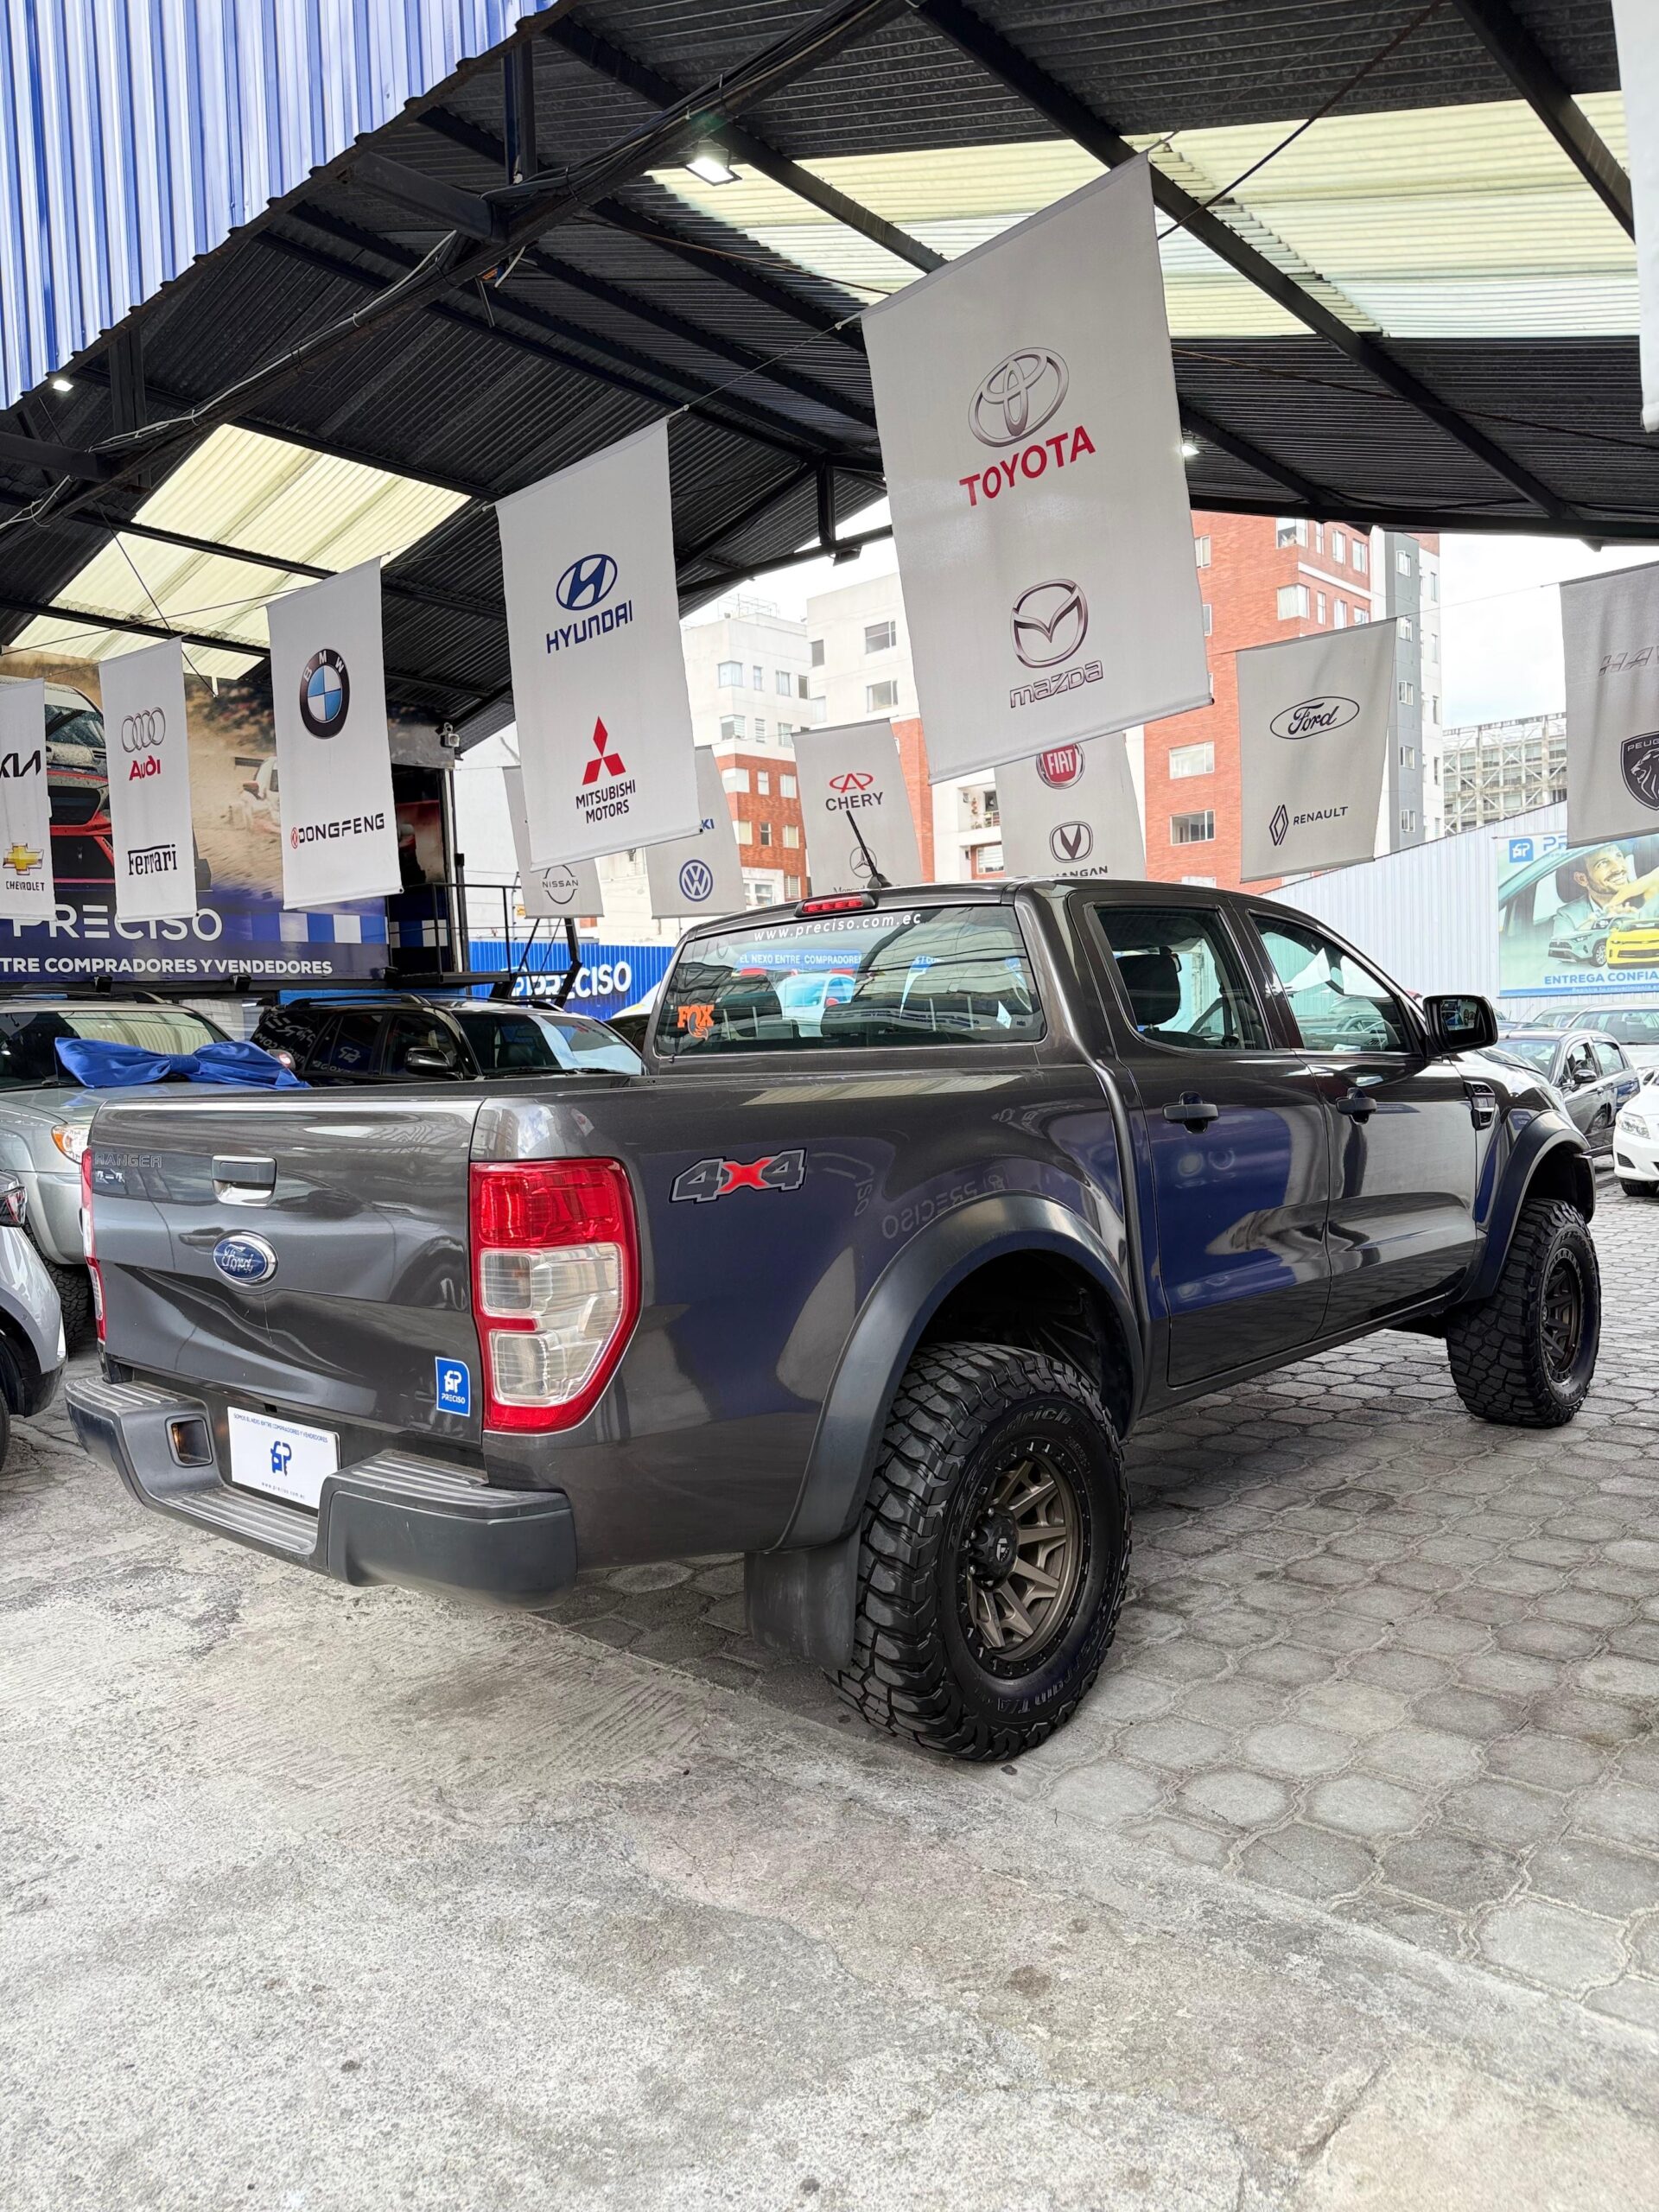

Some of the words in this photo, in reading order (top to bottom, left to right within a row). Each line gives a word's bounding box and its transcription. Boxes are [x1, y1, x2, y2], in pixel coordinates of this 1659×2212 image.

[959, 425, 1096, 507] TOYOTA
[546, 600, 633, 654] HYUNDAI
[303, 650, 344, 681] BMW
[1288, 702, 1340, 734] Ford
[130, 755, 162, 780] Audi
[1046, 749, 1074, 775] FIAT
[575, 779, 636, 809] MITSUBISHI
[825, 792, 883, 811] CHERY
[586, 799, 630, 823] MOTORS
[1294, 806, 1348, 825] RENAULT
[298, 812, 385, 844] DONGFENG
[128, 844, 177, 875] Ferrari
[6, 880, 45, 892] CHEVROLET
[542, 879, 579, 888] NISSAN
[754, 912, 922, 942] www.preciso.com.ec
[44, 957, 197, 974] COMPRADORES
[203, 959, 218, 973] Y
[218, 959, 334, 975] VENDEDORES
[751, 954, 773, 963] NEXO
[774, 954, 801, 964] ENTRE
[1544, 973, 1605, 985] ENTREGA
[677, 1004, 715, 1040] FOX
[95, 1153, 162, 1168] RANGER
[221, 1243, 254, 1274] Ford
[441, 1392, 466, 1404] PRECISO
